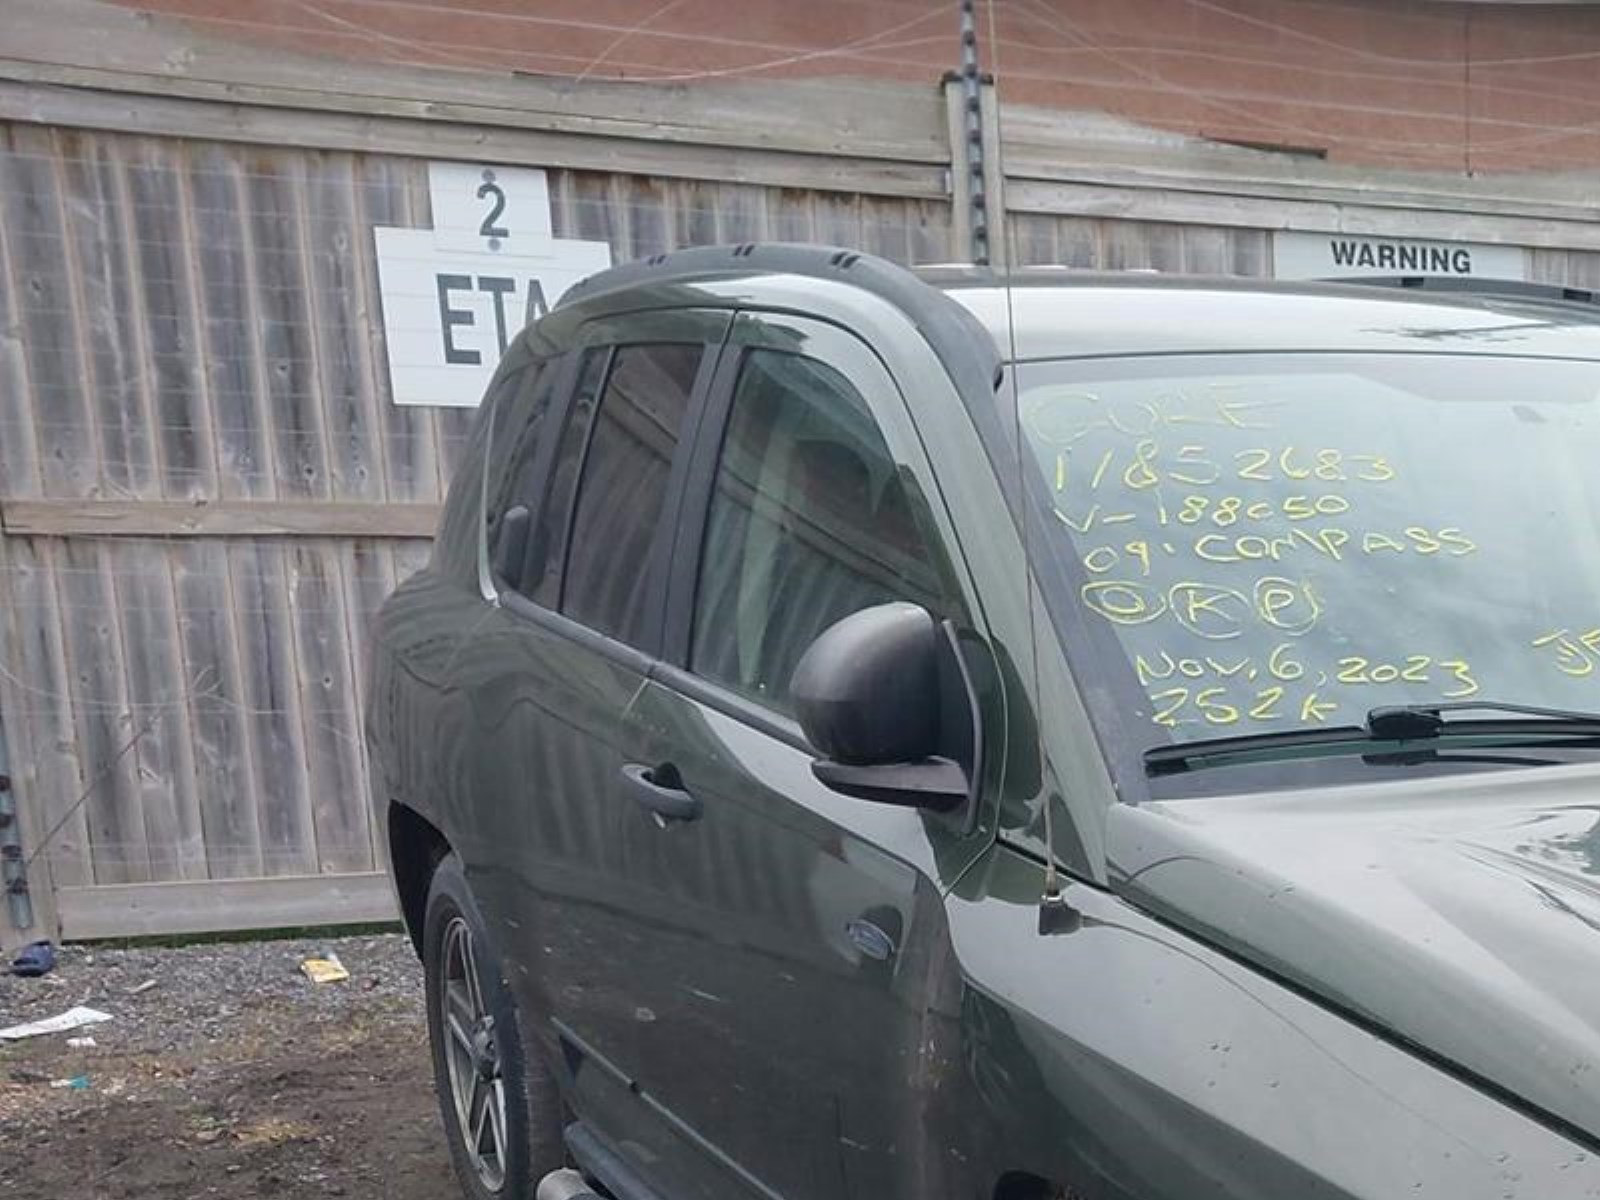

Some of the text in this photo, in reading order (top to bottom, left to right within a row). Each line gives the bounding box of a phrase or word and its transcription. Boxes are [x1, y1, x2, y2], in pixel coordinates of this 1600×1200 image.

[475, 181, 511, 239] 2
[1331, 240, 1471, 275] WARNING
[1055, 438, 1398, 490] 11852683
[1336, 654, 1480, 697] 2023
